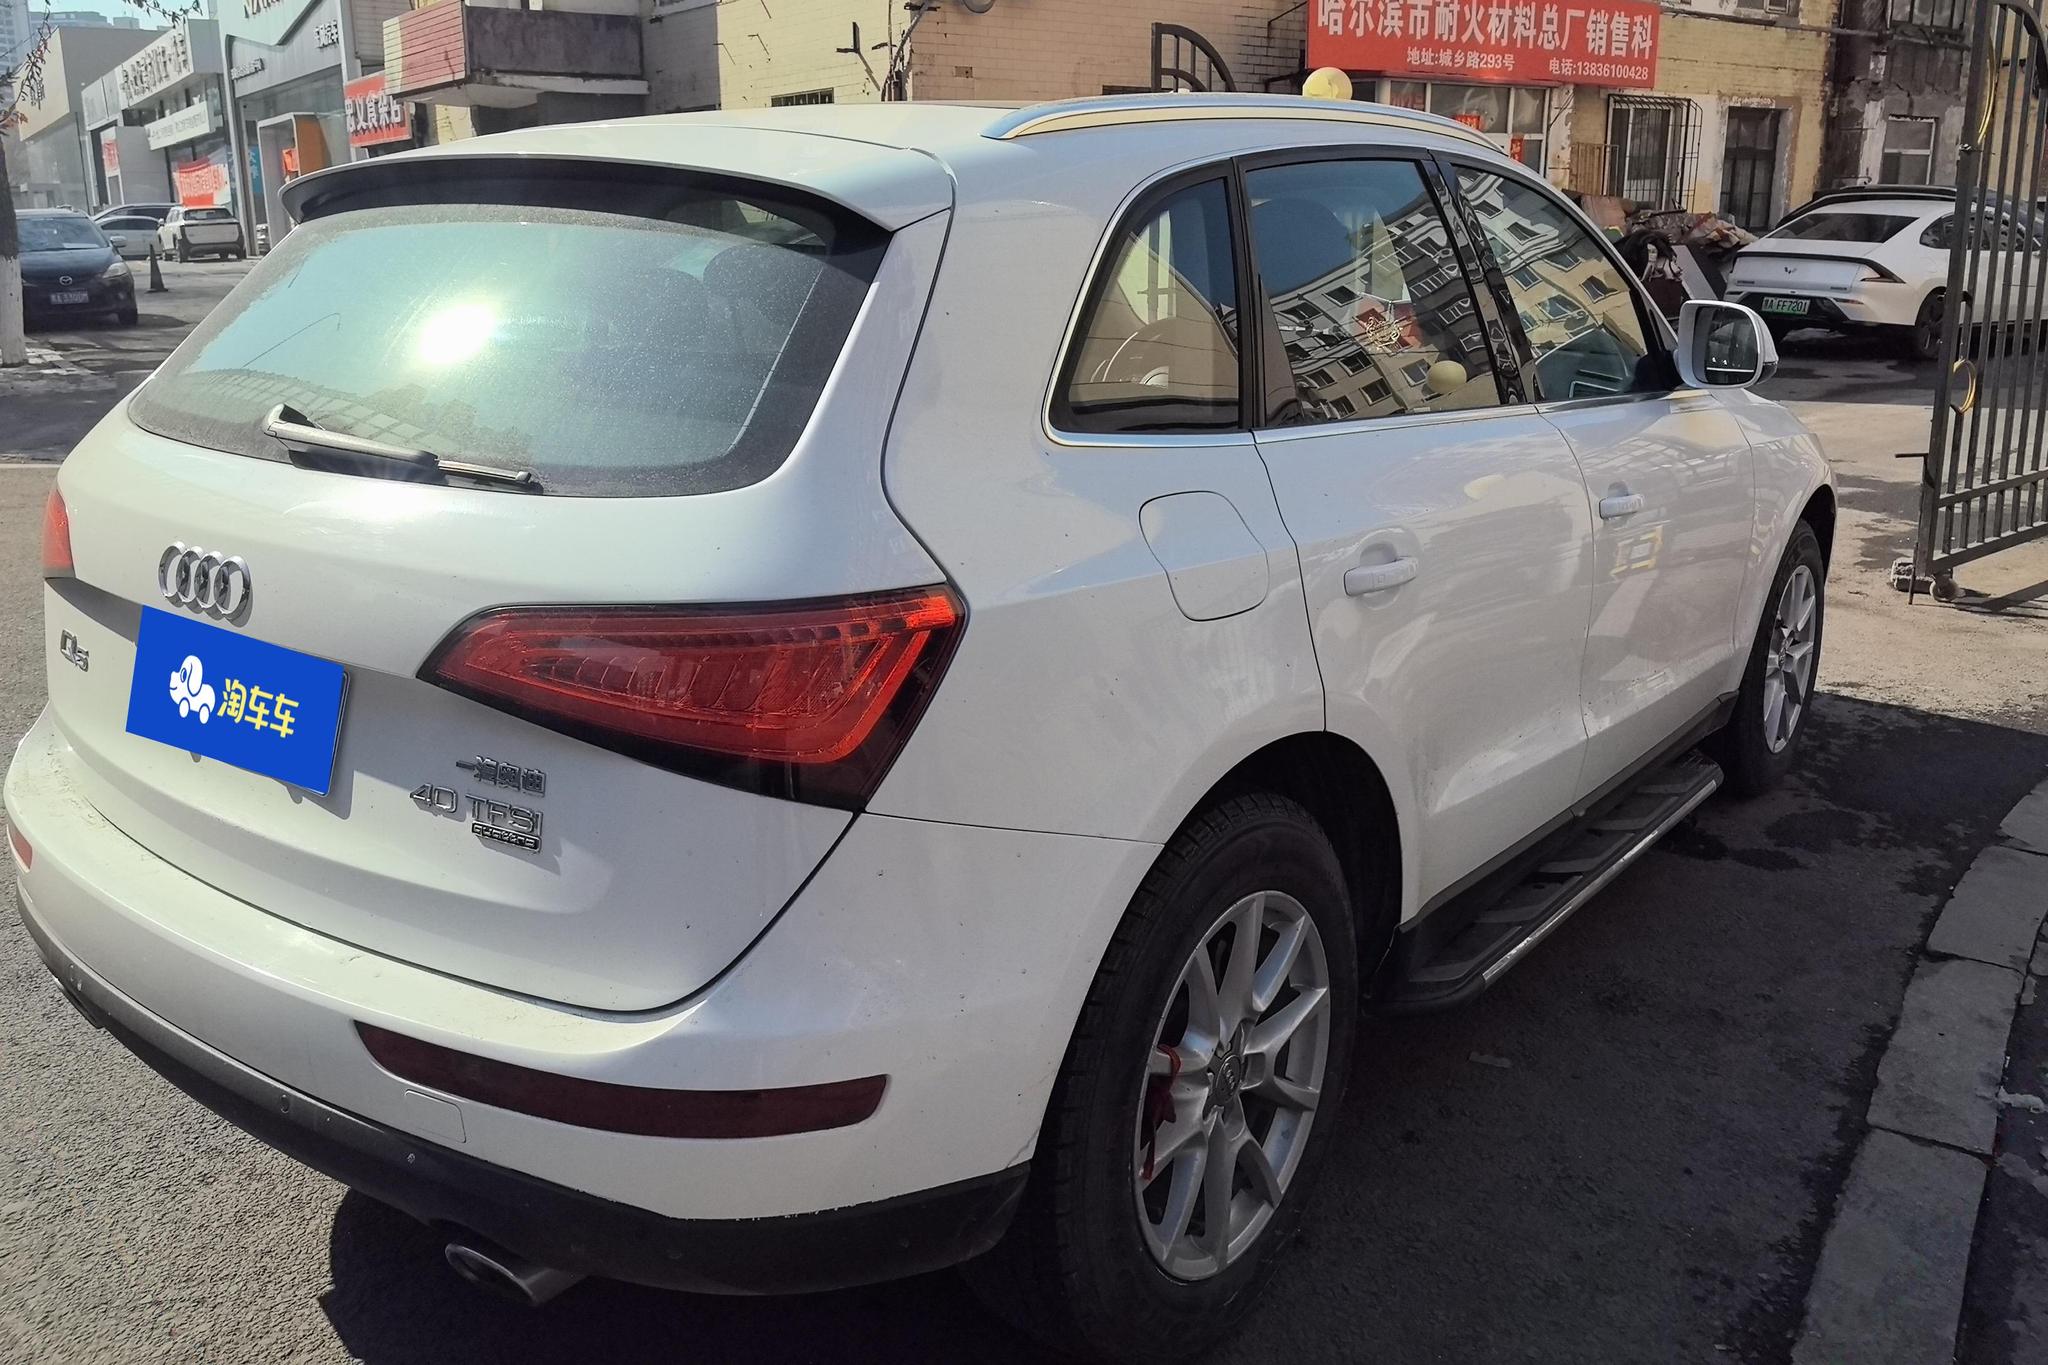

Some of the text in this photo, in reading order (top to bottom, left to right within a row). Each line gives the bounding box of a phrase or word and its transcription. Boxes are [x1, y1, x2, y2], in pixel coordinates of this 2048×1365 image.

[1317, 0, 1653, 60] 哈尔滨市耐火材料总厂销售科
[1407, 46, 1516, 71] 地址:城乡路293号
[1549, 57, 1649, 80] 电话:13836100428
[60, 629, 90, 672] Q5
[455, 754, 547, 798] 一汽奥迪
[409, 783, 544, 838] 40 TFSI
